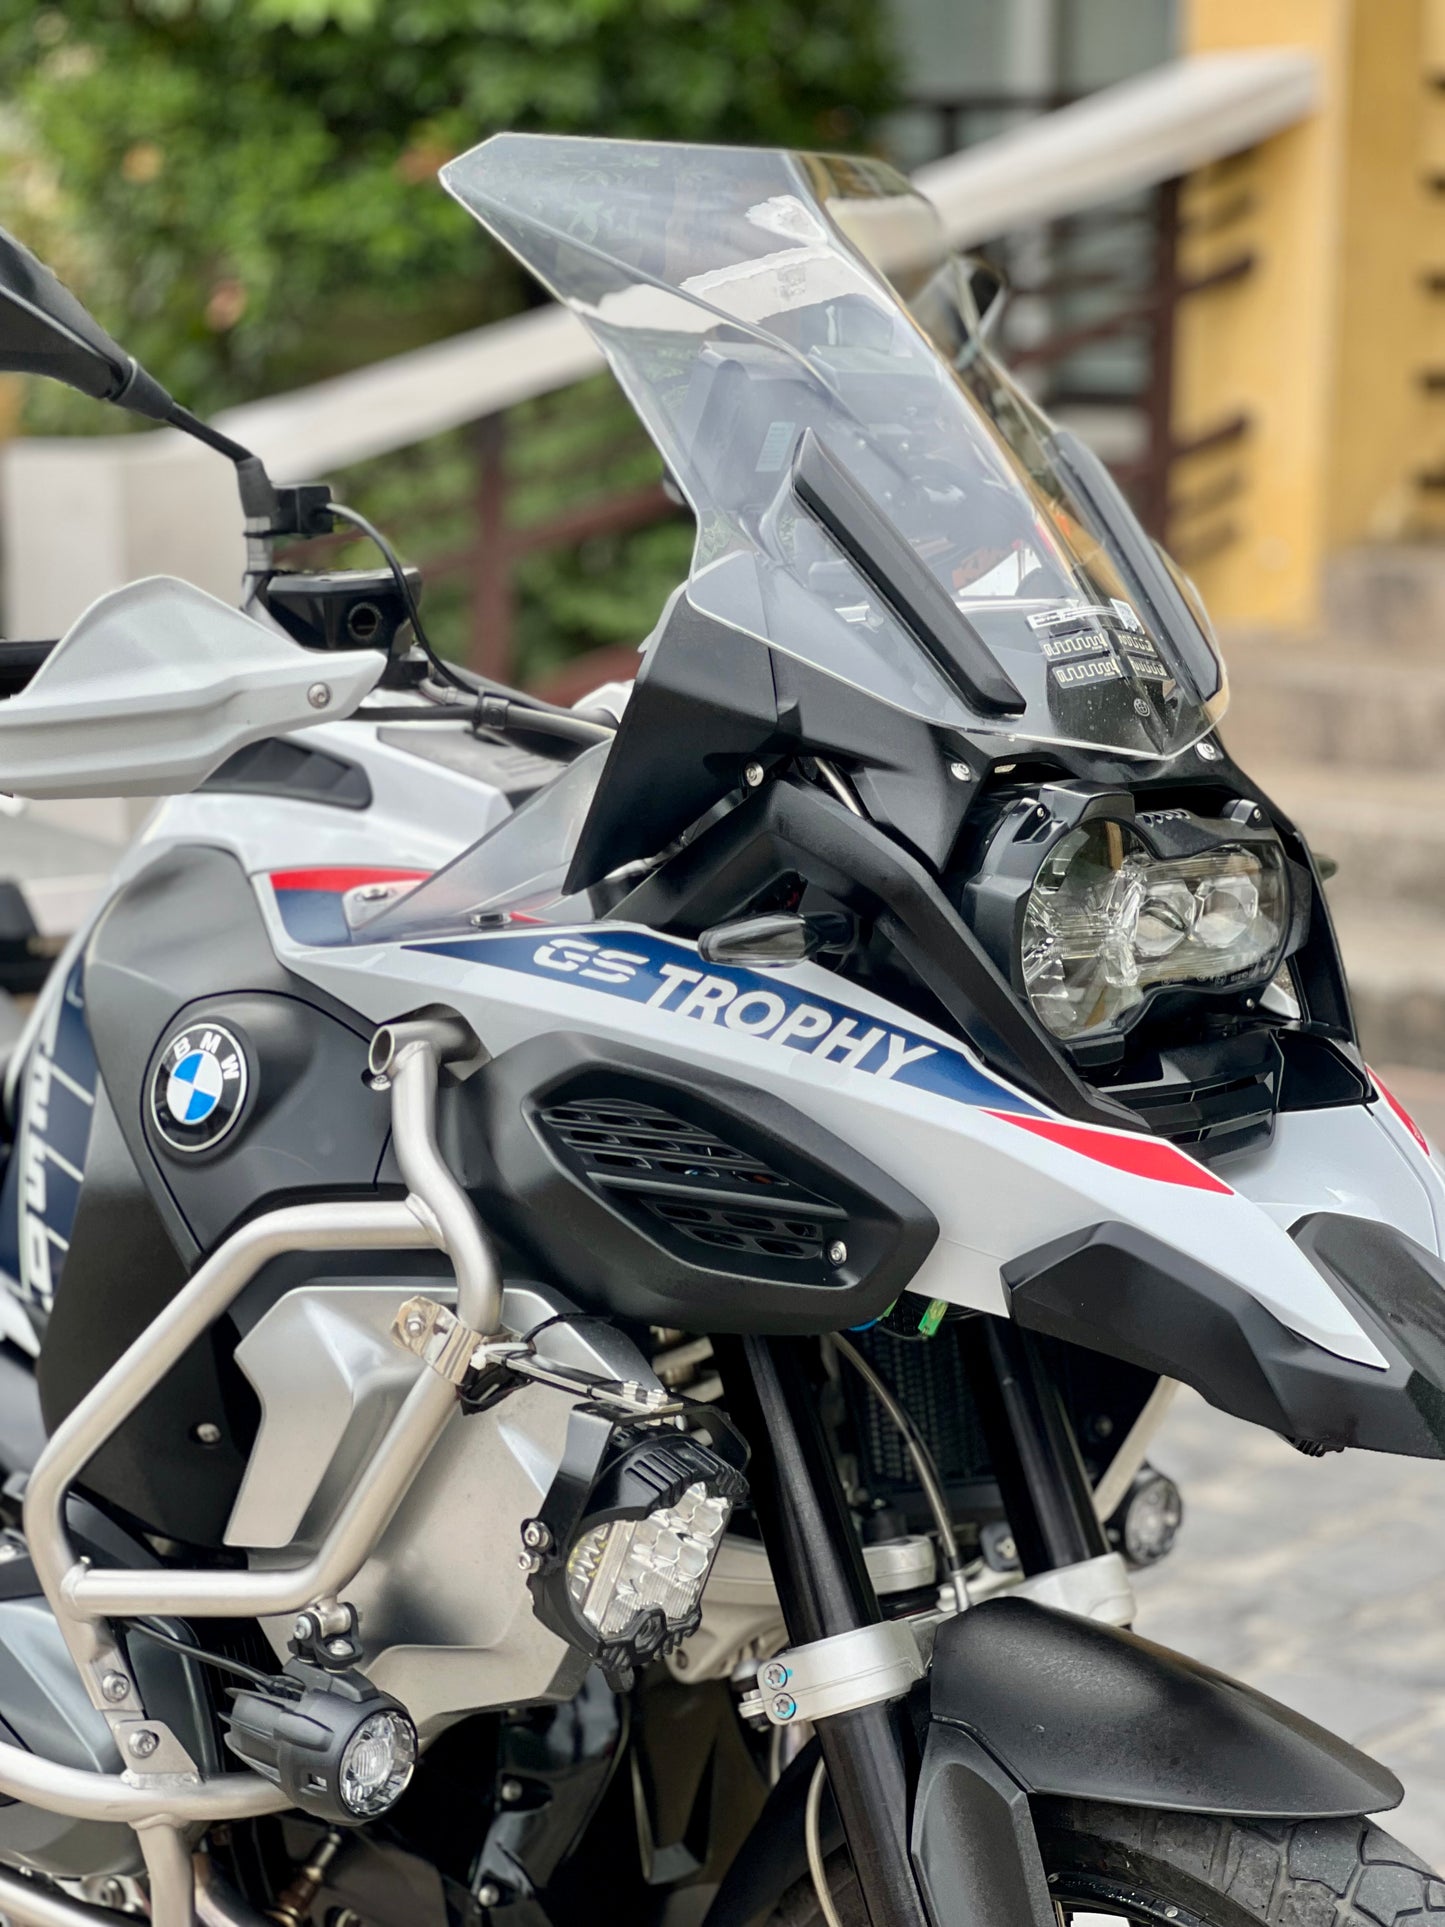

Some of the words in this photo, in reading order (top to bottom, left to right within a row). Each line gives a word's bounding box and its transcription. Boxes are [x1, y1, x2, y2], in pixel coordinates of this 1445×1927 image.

[173, 1031, 241, 1081] BMW
[533, 939, 650, 984] GS
[646, 964, 939, 1079] TROPHY
